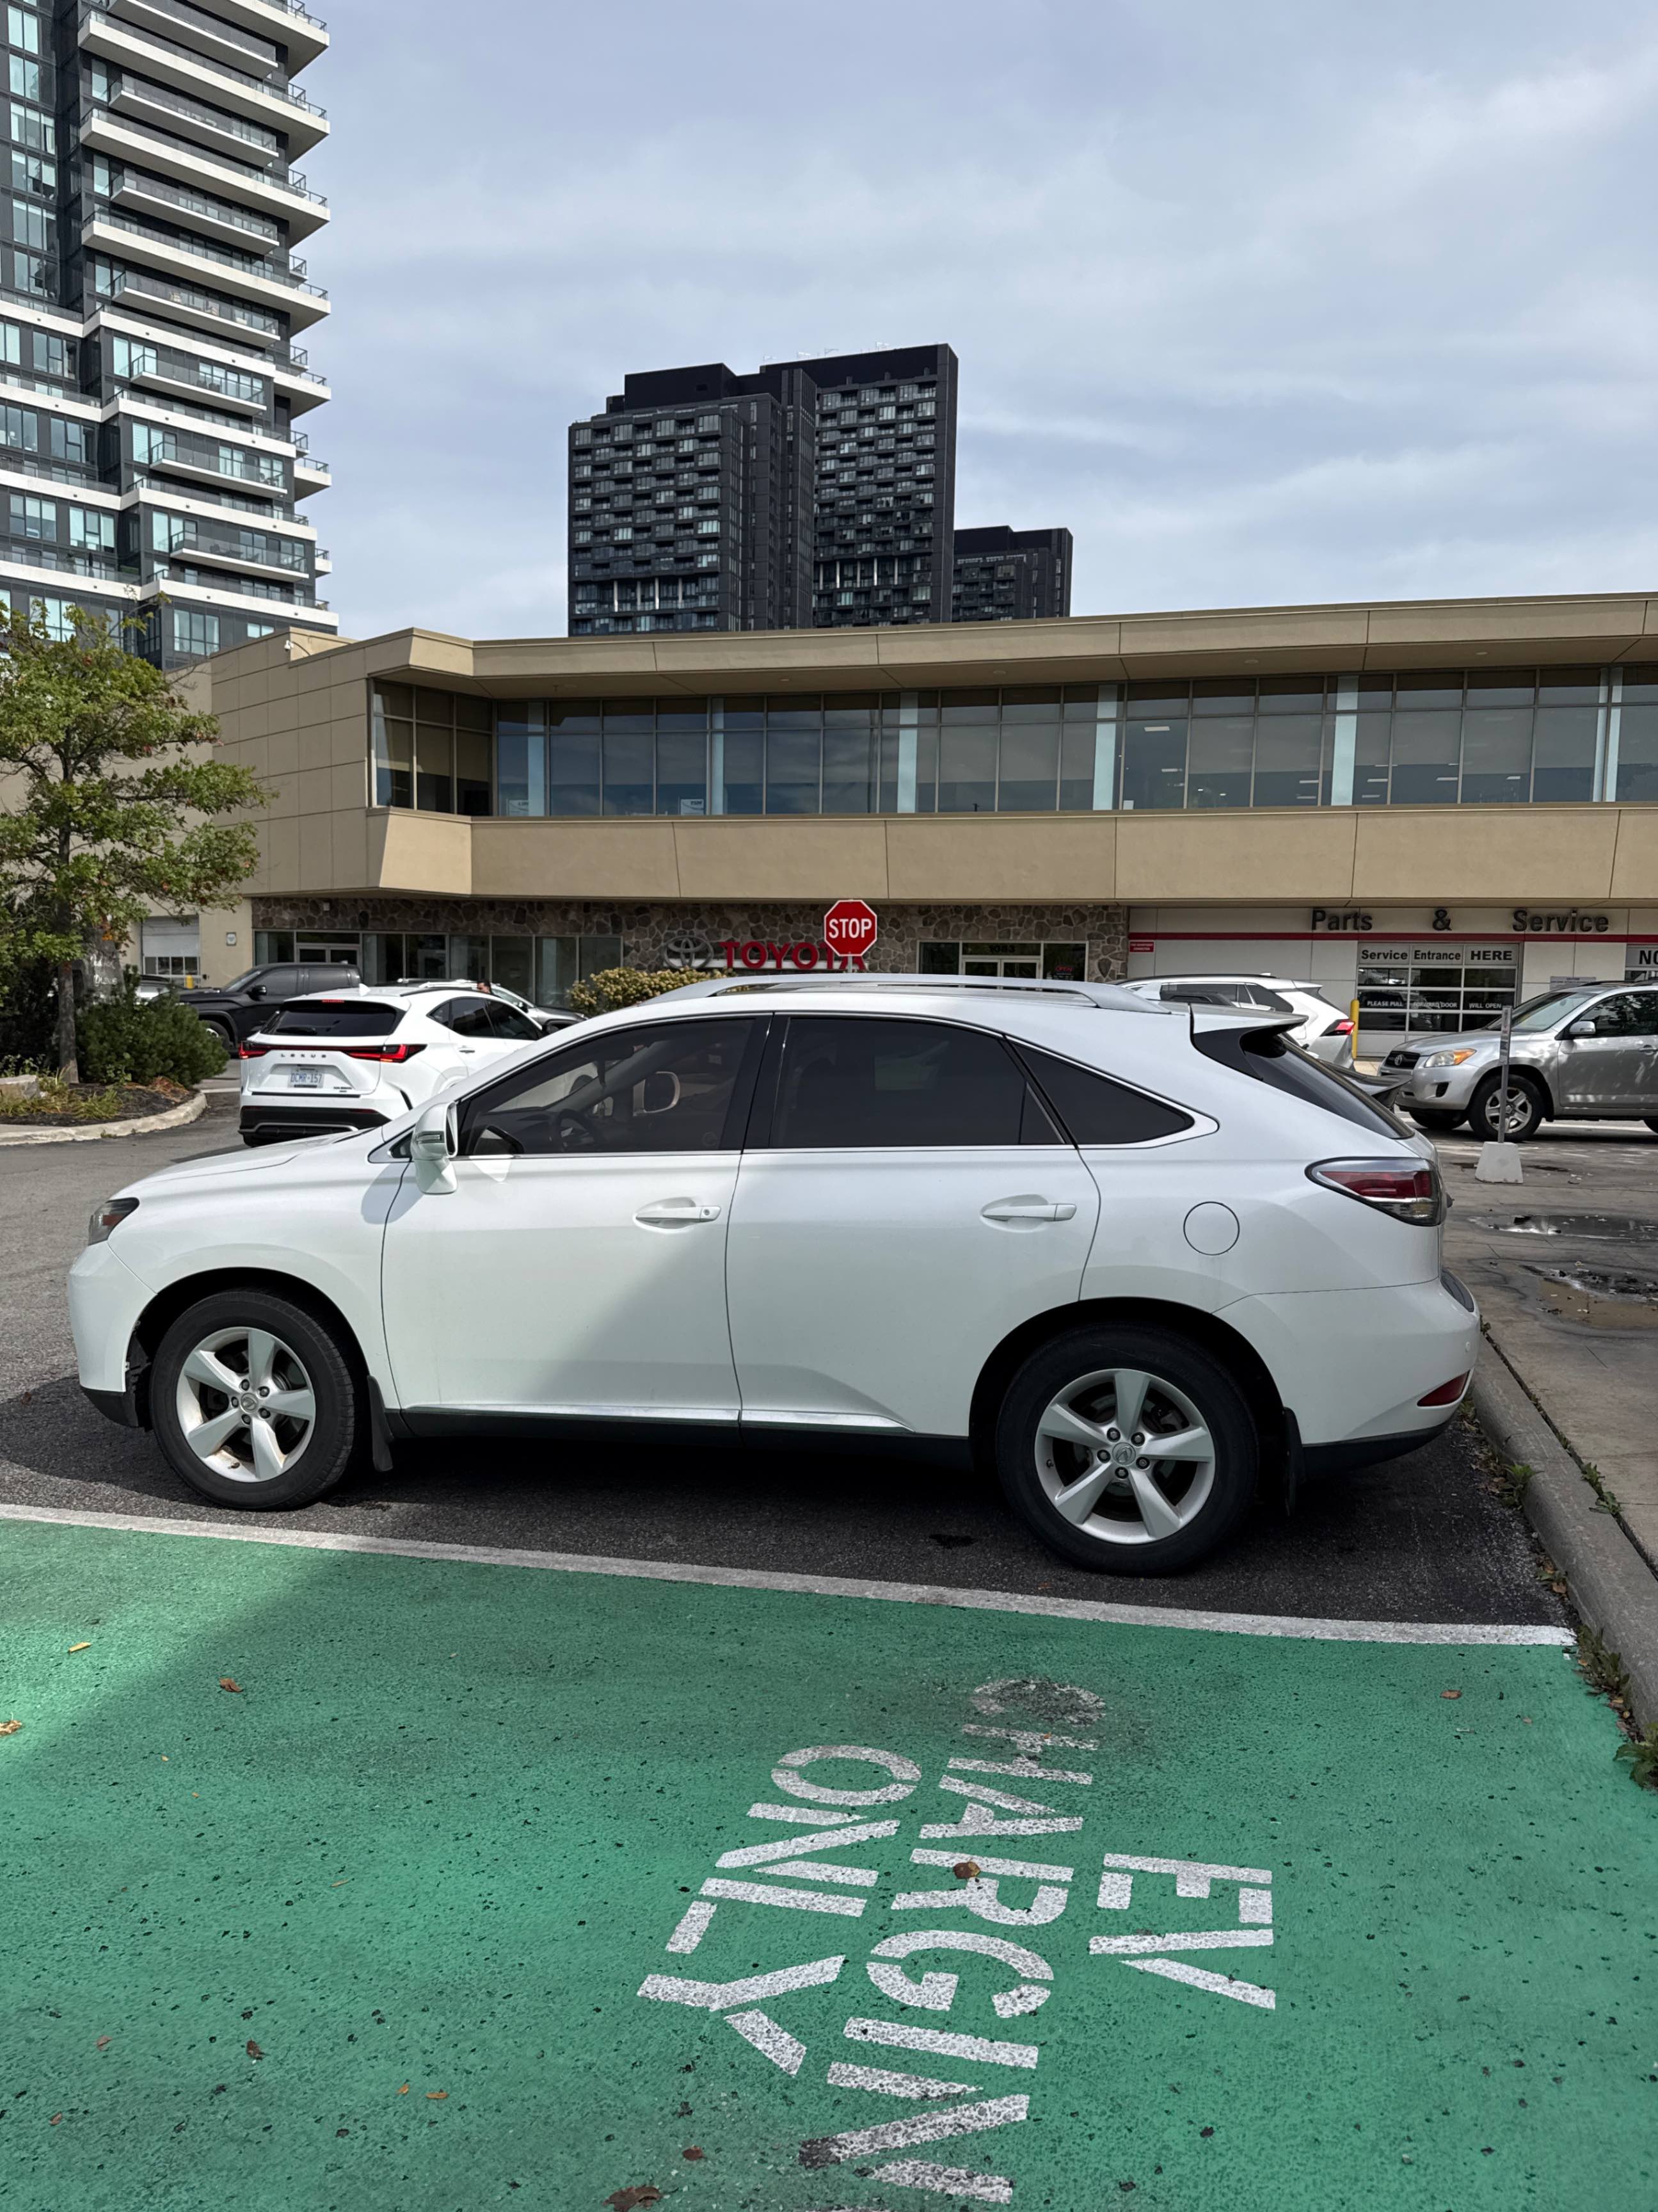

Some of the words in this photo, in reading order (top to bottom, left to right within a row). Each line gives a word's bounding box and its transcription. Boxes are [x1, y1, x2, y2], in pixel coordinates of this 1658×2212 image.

[828, 918, 872, 938] STOP
[1312, 910, 1373, 931] Parts
[1432, 909, 1452, 931] &
[1513, 910, 1609, 933] Service
[1361, 950, 1408, 960] Service
[1414, 950, 1461, 961] Entrance
[1471, 950, 1513, 961] HERE
[637, 1745, 922, 2078] ONLY
[798, 1676, 1106, 2212] CHARGIN
[1089, 1854, 1276, 2010] EV
